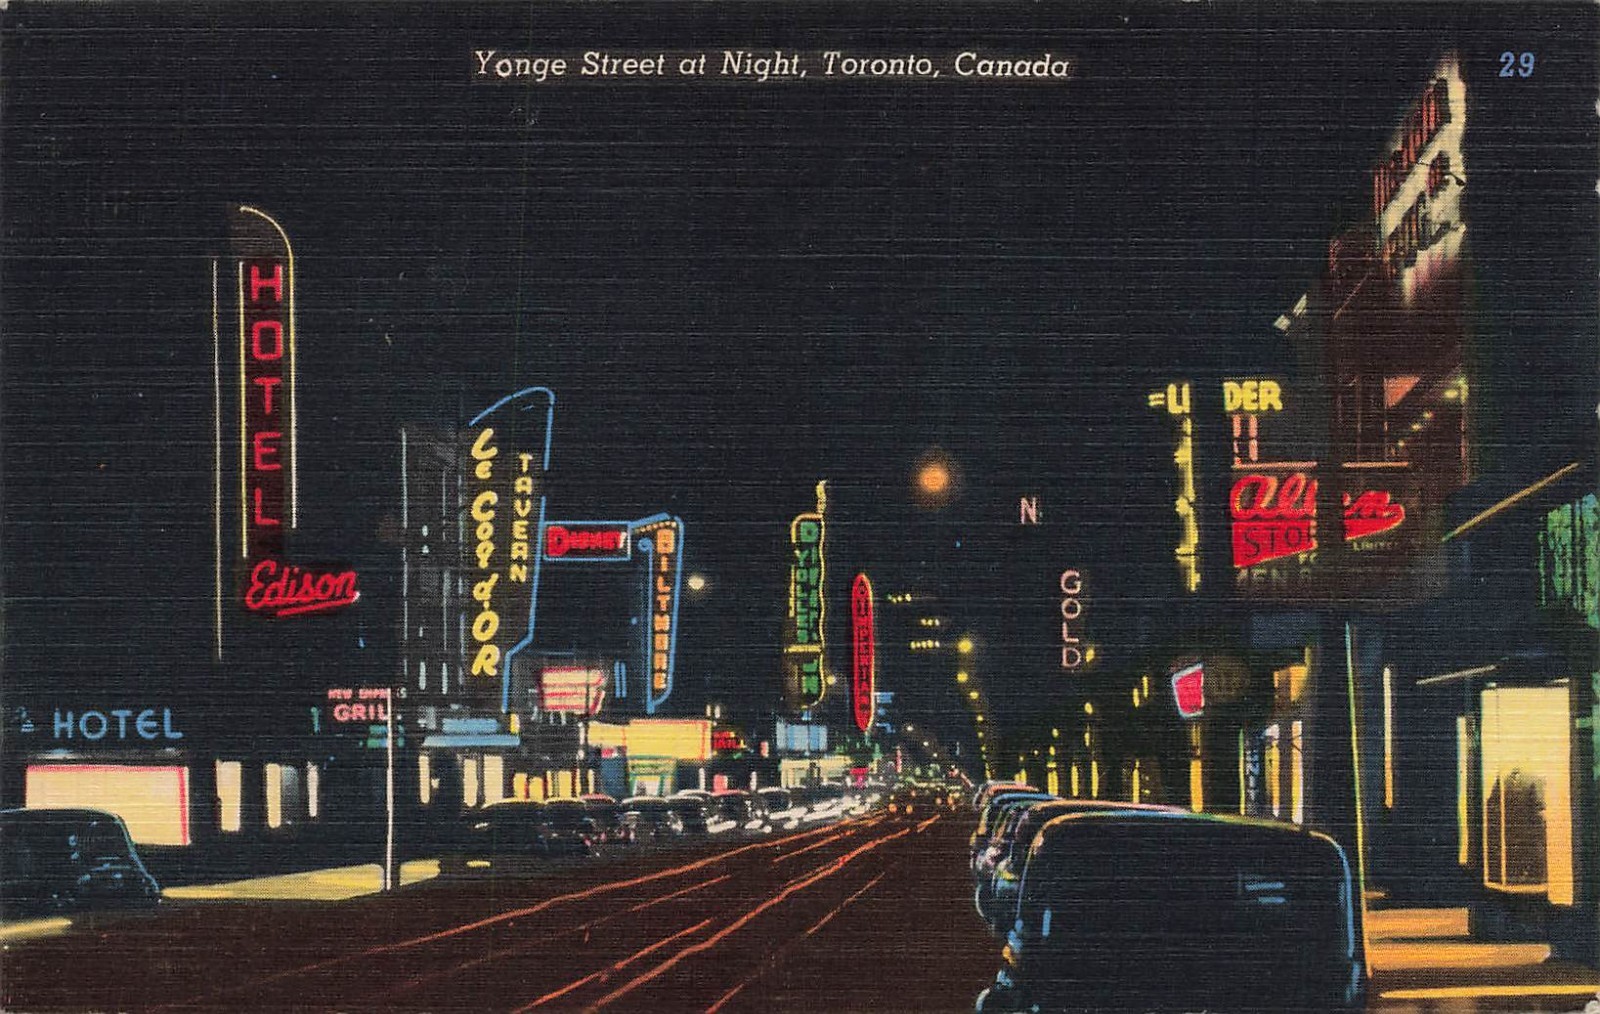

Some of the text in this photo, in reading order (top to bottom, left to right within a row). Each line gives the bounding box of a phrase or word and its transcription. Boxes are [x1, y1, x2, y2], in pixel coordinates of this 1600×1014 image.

[250, 264, 284, 527] HOTEL
[509, 453, 534, 583] TAVERN
[245, 559, 359, 617] Edison
[1060, 569, 1082, 668] GOLD
[53, 708, 184, 740] HOTEL
[333, 703, 401, 722] GRIL
